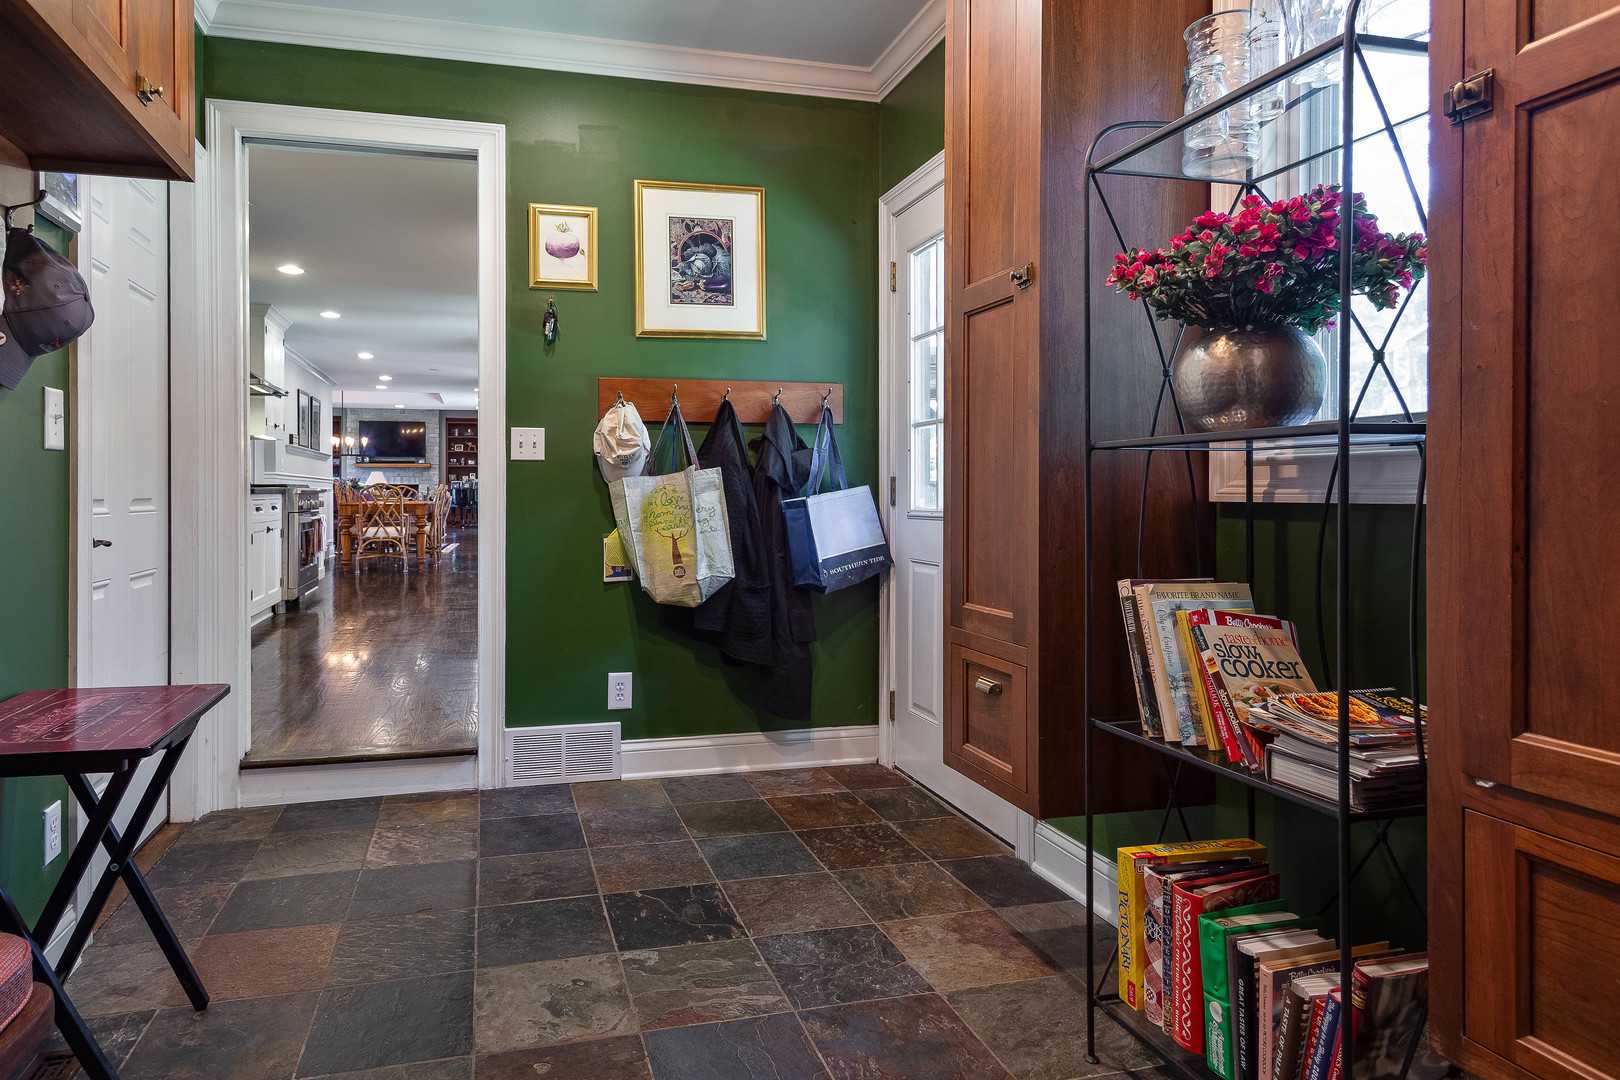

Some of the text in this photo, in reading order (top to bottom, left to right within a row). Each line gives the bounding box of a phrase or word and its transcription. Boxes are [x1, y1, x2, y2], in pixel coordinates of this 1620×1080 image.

[830, 556, 885, 575] SOUTHERN TIDE
[1225, 616, 1243, 628] Betty
[1214, 638, 1257, 659] slow
[1224, 633, 1250, 645] taste
[1255, 631, 1290, 646] home
[1220, 653, 1303, 679] cooker
[1219, 688, 1242, 735] slow cooker
[1174, 893, 1183, 914] Betty
[1118, 890, 1130, 976] PICTIONARY
[1174, 914, 1183, 946] Crocker's
[1281, 1007, 1290, 1035] TASTE
[1240, 1037, 1246, 1050] OF
[1279, 1035, 1285, 1050] OF
[1274, 1050, 1284, 1075] PALM
